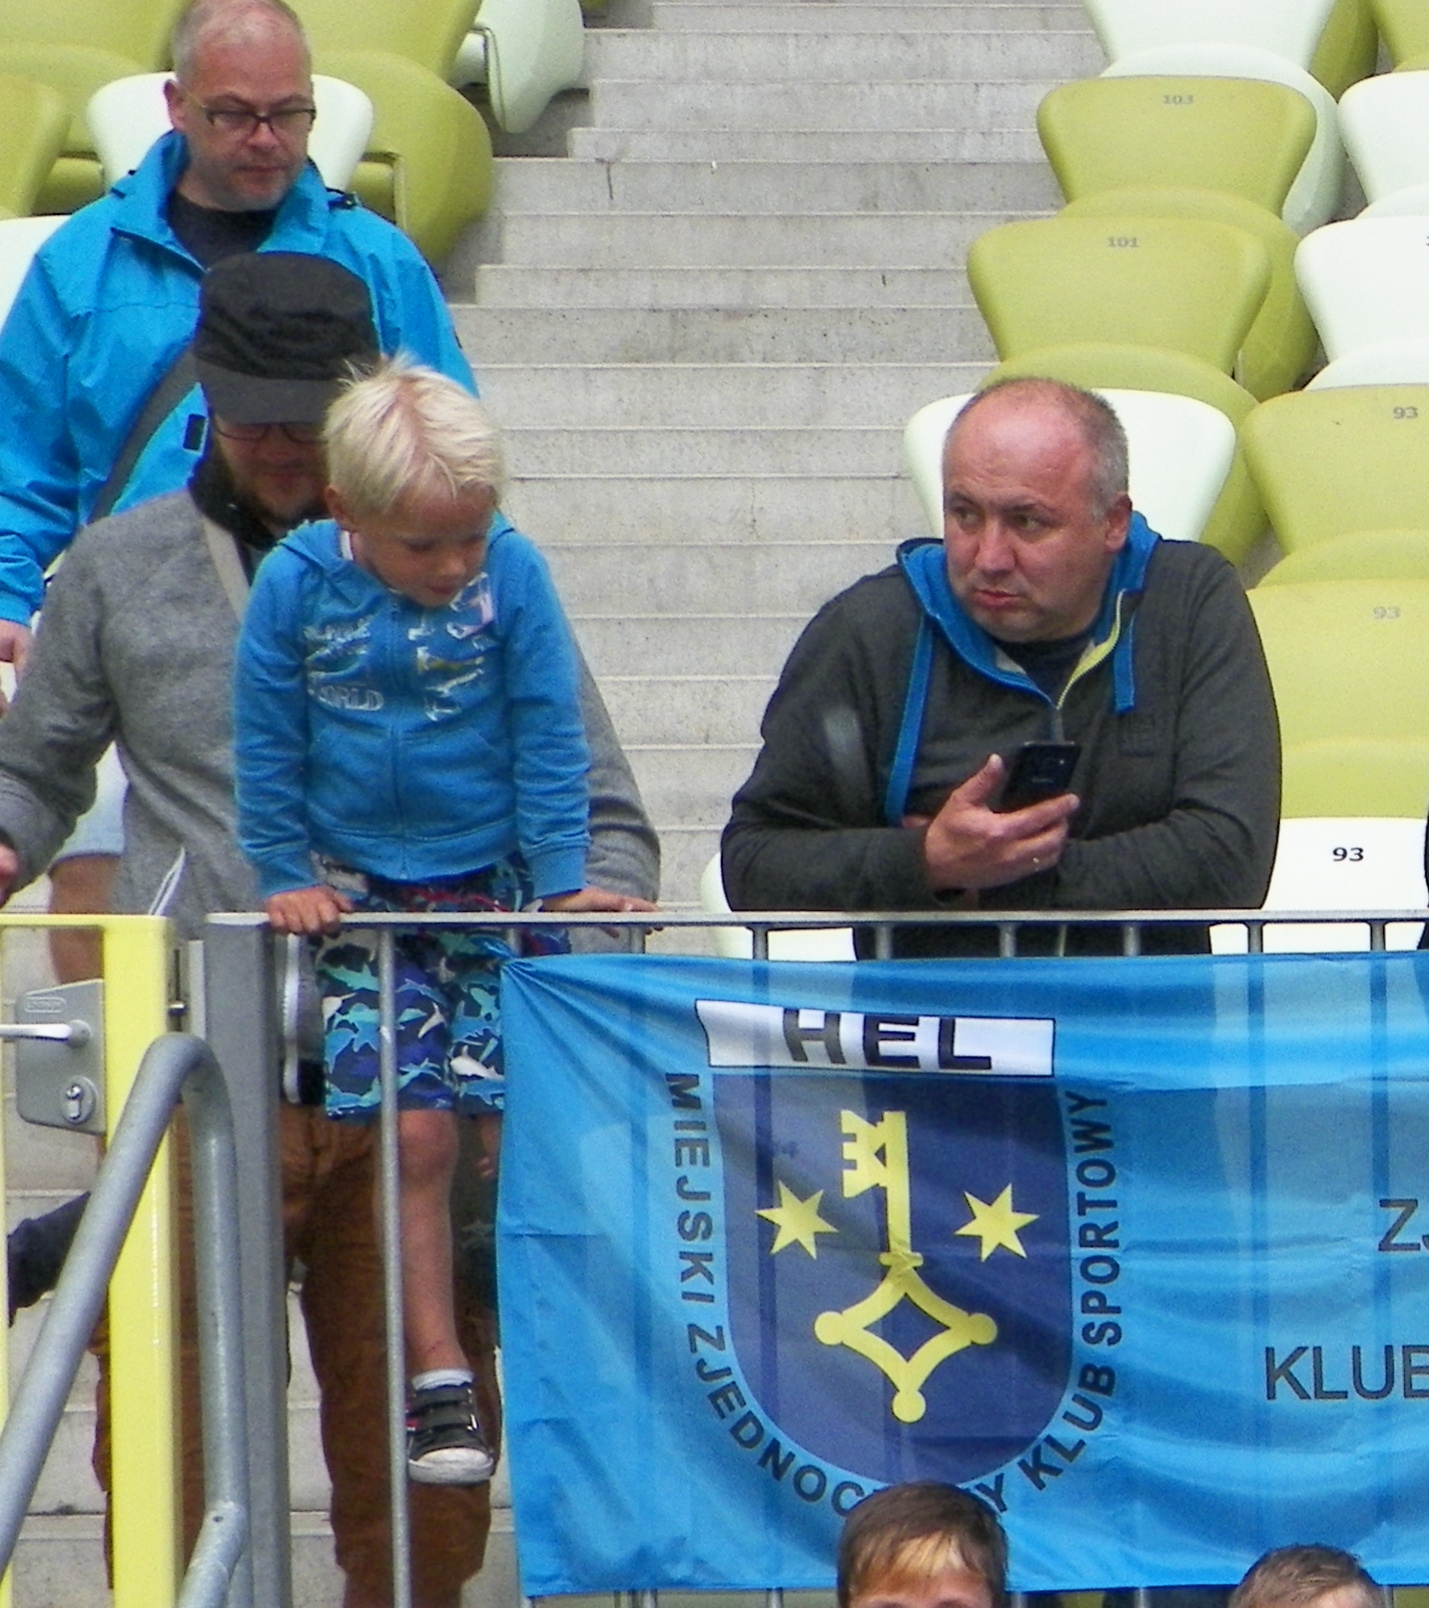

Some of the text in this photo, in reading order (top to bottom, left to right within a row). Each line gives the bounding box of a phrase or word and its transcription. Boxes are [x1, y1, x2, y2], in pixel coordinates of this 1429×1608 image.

[1392, 405, 1419, 419] 93
[1332, 846, 1365, 863] 93
[782, 1008, 992, 1070] HEL
[664, 1072, 1124, 1516] MIEJSKI ZJEDNOCY KLUB SPORTOWY
